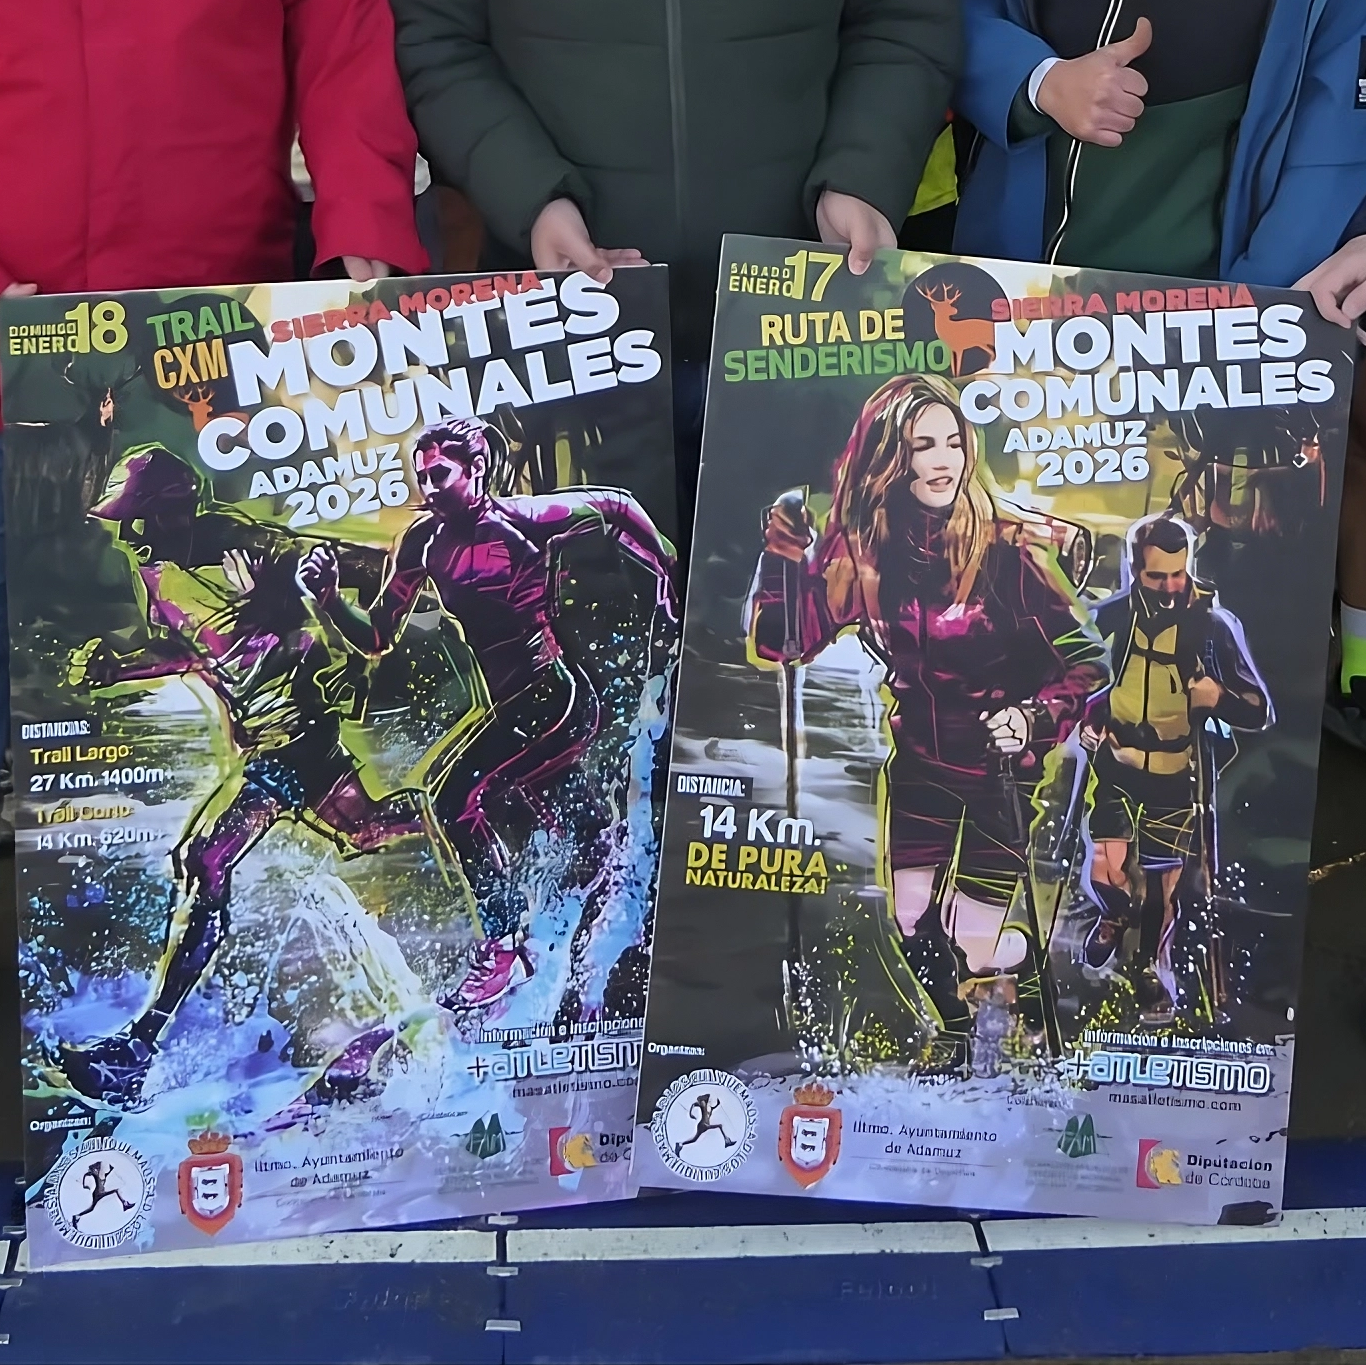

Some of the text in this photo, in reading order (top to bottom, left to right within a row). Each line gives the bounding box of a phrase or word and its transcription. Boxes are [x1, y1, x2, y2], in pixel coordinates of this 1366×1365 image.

[729, 275, 794, 297] ENERO
[784, 249, 844, 302] 17
[146, 300, 256, 347] TRAIL
[269, 271, 543, 344] SIERRA MORENA
[990, 284, 1259, 322] SIERRA MORENA
[9, 335, 79, 355] ENERO
[65, 300, 128, 354] 18
[228, 270, 620, 408] MONTES
[760, 308, 905, 347] RUTA DE
[992, 304, 1307, 374] MONTES
[153, 338, 229, 390] CXM
[723, 338, 951, 383] SENDERISMO
[197, 329, 662, 472] COMUNALES
[958, 360, 1335, 426] COMUNALES
[1002, 421, 1148, 454] ADAMUZ
[248, 444, 403, 500] ADAMUZ
[1036, 446, 1150, 488] 2026
[287, 468, 410, 529] 2026
[30, 746, 72, 765] Trail
[30, 774, 55, 792] 27
[699, 804, 822, 846] 14 Km.
[687, 842, 828, 877] DE PURA
[685, 868, 830, 895] NATURALEZA!
[884, 1141, 962, 1159] de Adamuz
[898, 1124, 998, 1142] Ayuntamiento
[302, 1147, 404, 1169] Ayuntamiento
[312, 1169, 373, 1185] Adamuz
